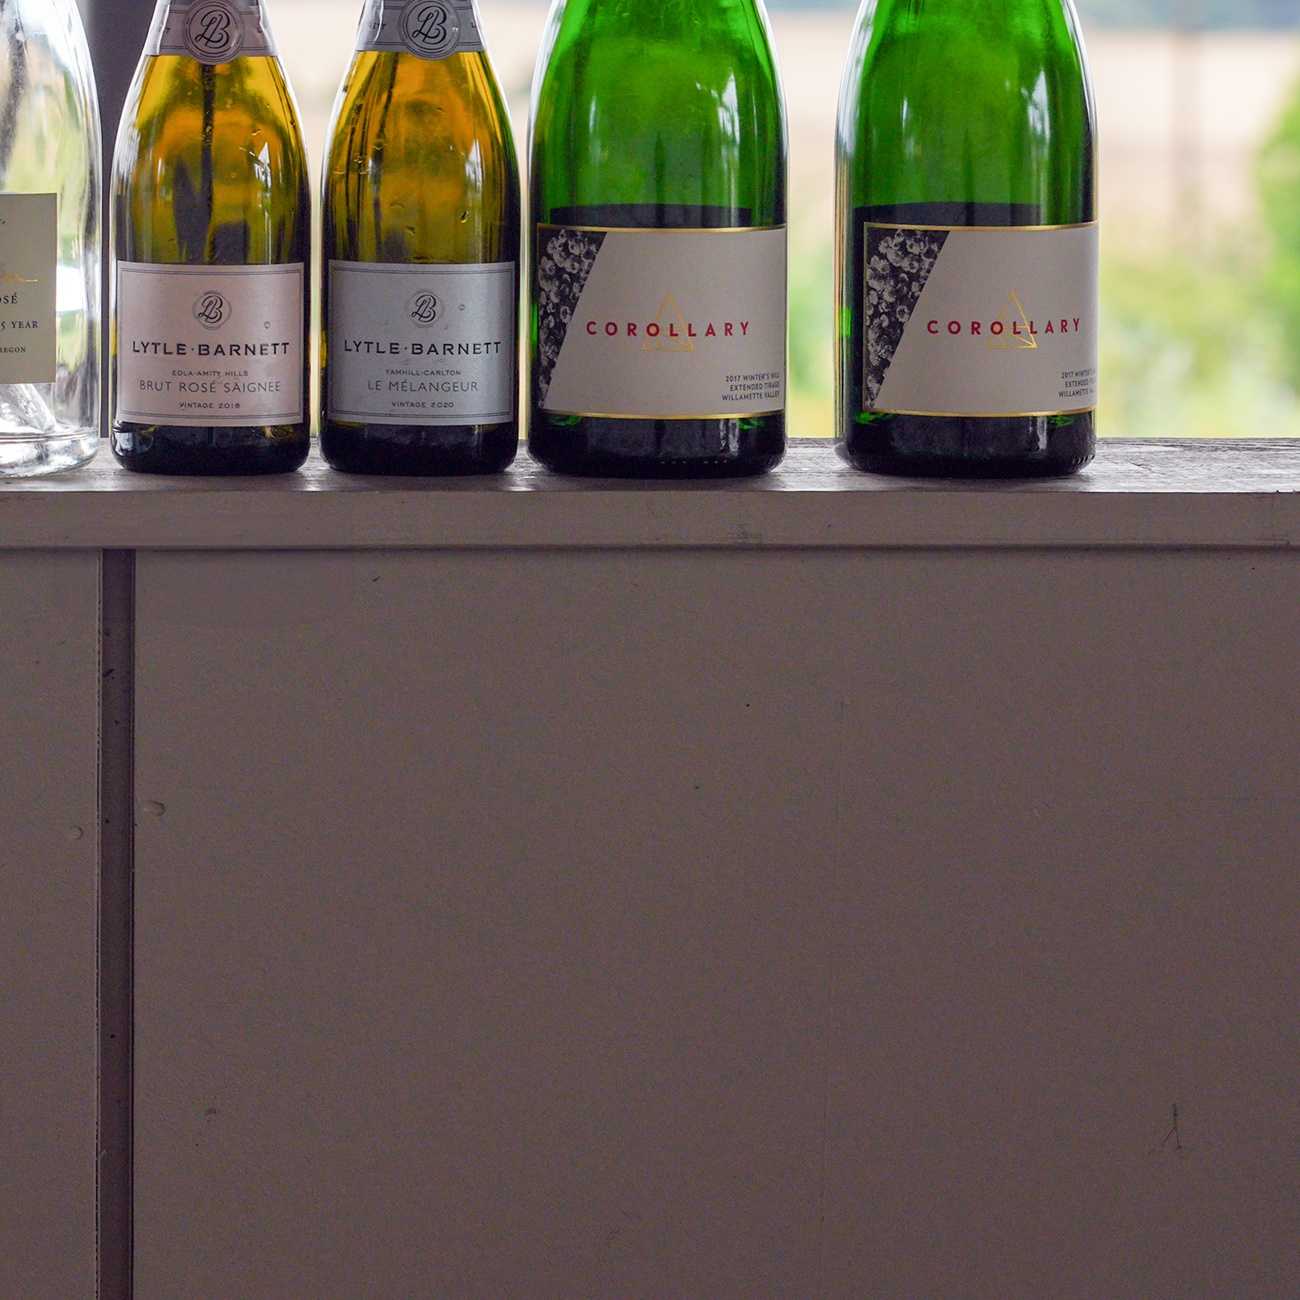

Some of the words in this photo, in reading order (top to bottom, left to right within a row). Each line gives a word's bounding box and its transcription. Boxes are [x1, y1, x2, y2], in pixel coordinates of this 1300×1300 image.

[1, 322, 6, 331] 5
[12, 321, 39, 329] YEAR
[586, 321, 750, 338] COROLLARY
[927, 318, 1080, 335] COROLLARY
[743, 373, 769, 381] WINTER'S
[140, 380, 172, 392] BRUT
[179, 380, 216, 393] ROSÉ
[368, 380, 381, 390] LE
[388, 379, 478, 392] MÉLANGEUR
[730, 383, 763, 392] EXTENDED
[1065, 378, 1089, 388] EXTENDED
[722, 392, 762, 401] WILLAMETTE
[1058, 388, 1089, 397] WILLAMETTE
